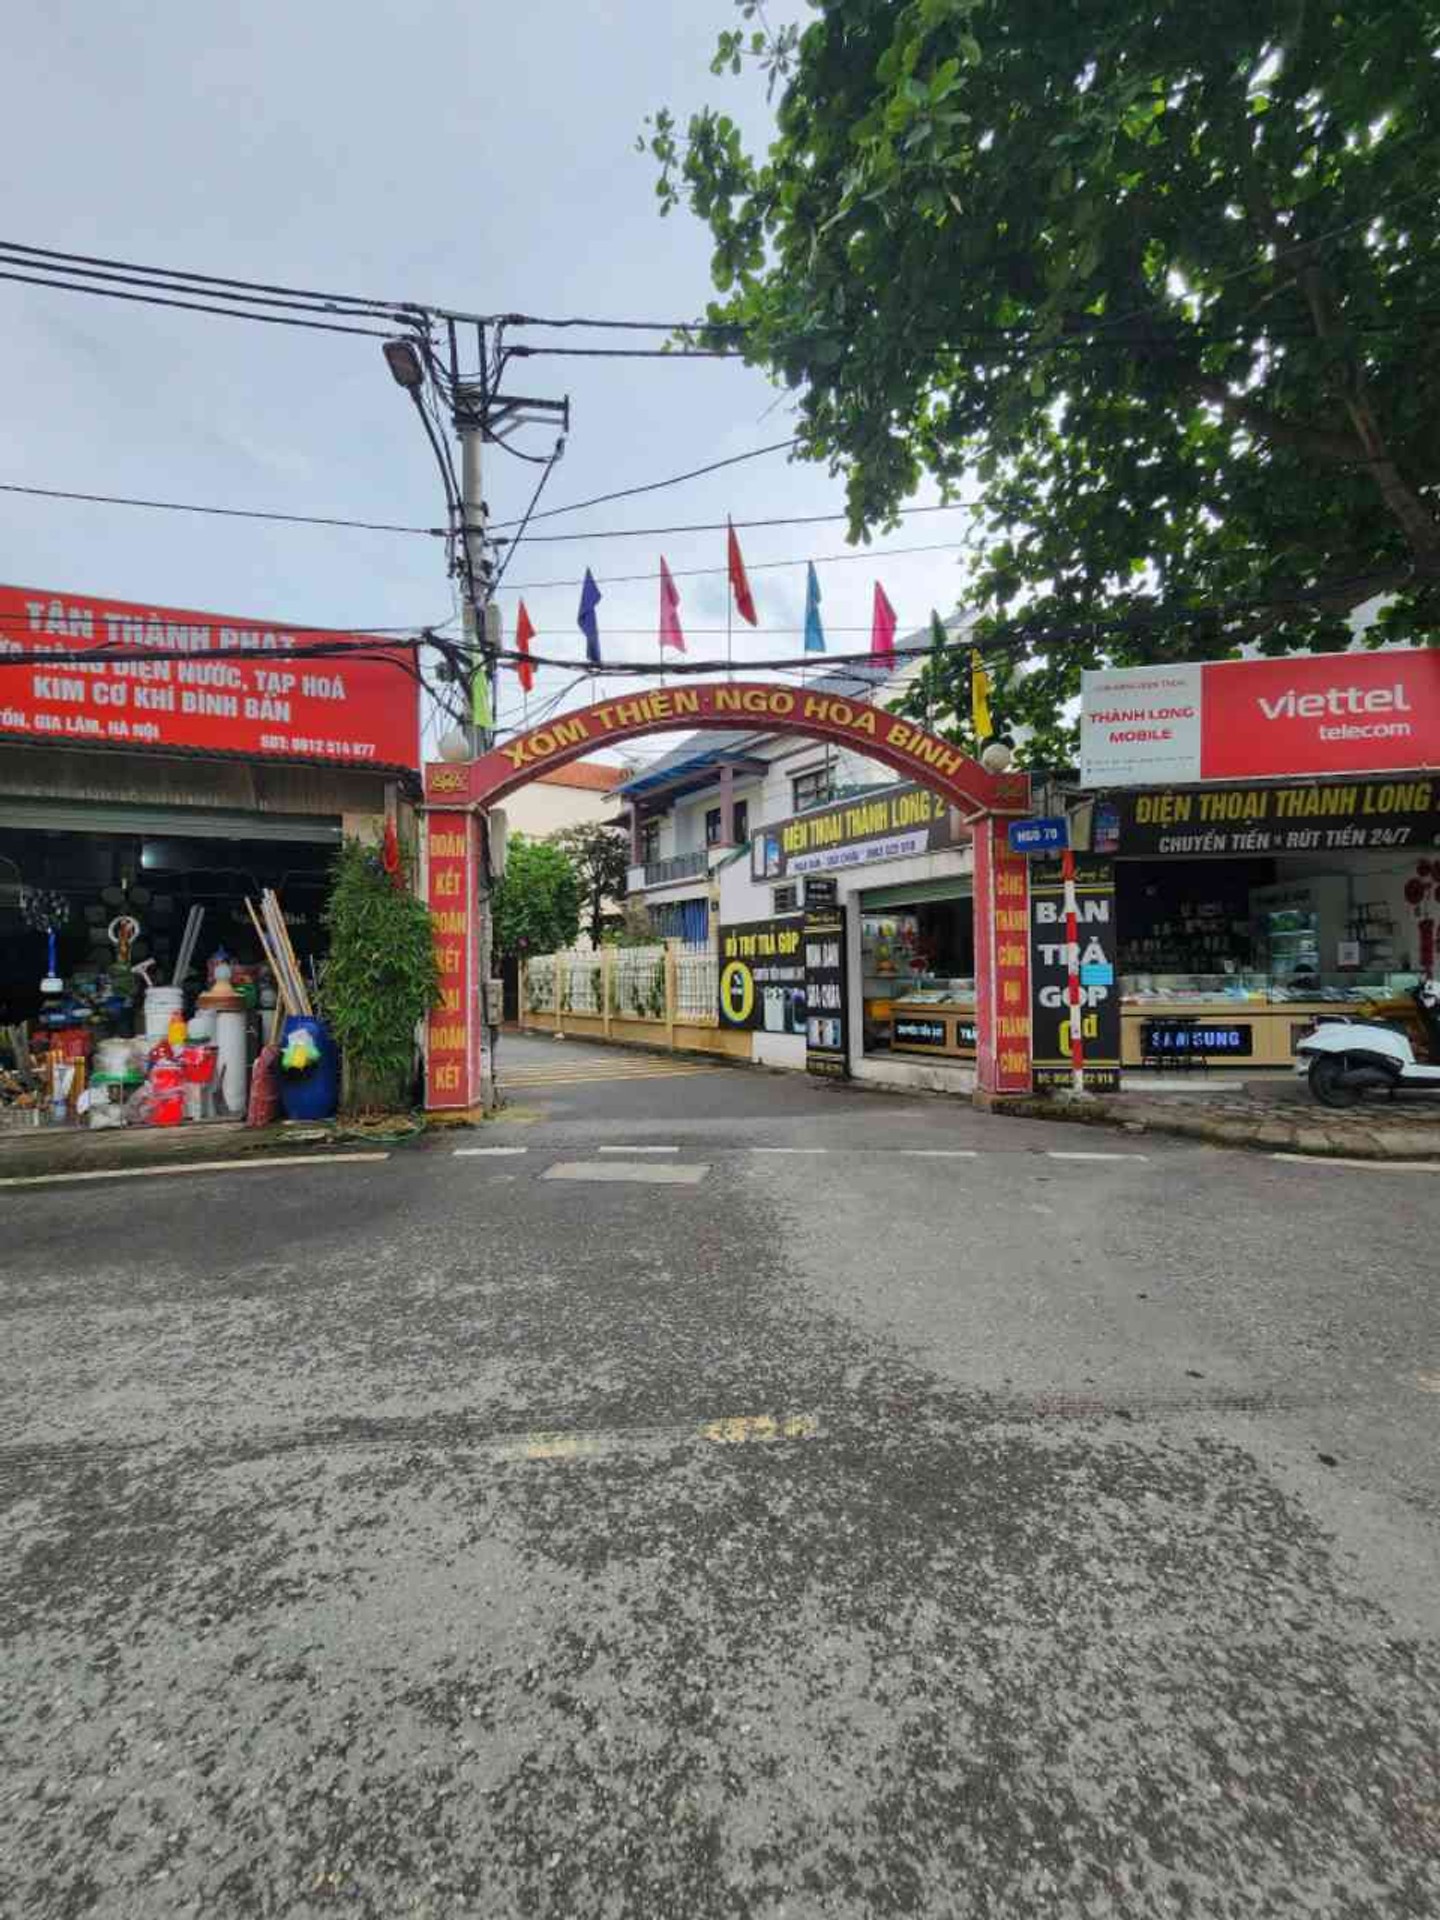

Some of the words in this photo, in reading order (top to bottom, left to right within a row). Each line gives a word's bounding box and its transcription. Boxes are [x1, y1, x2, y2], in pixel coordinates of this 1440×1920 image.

[26, 600, 93, 638] TÂN
[105, 613, 208, 652] THÀNH
[33, 676, 85, 703] KIM
[134, 685, 175, 711] KHÍ
[254, 669, 295, 695] TẠP
[1089, 708, 1146, 724] THÀNH
[1149, 706, 1195, 721] LONG
[1257, 684, 1412, 720] viettel
[500, 717, 589, 769] XÓM
[1109, 729, 1174, 744] MOBILE
[1319, 723, 1411, 740] telecom
[891, 789, 931, 828] LONG
[934, 793, 946, 818] 2
[1135, 790, 1192, 829] ĐIỆN
[1200, 791, 1267, 825] THOẠI
[1276, 784, 1356, 818] THÀNH
[1362, 782, 1431, 814] LONG
[1043, 827, 1058, 840] 70
[1368, 827, 1412, 846] 24/7
[1152, 1031, 1240, 1046] SAMSUNG
